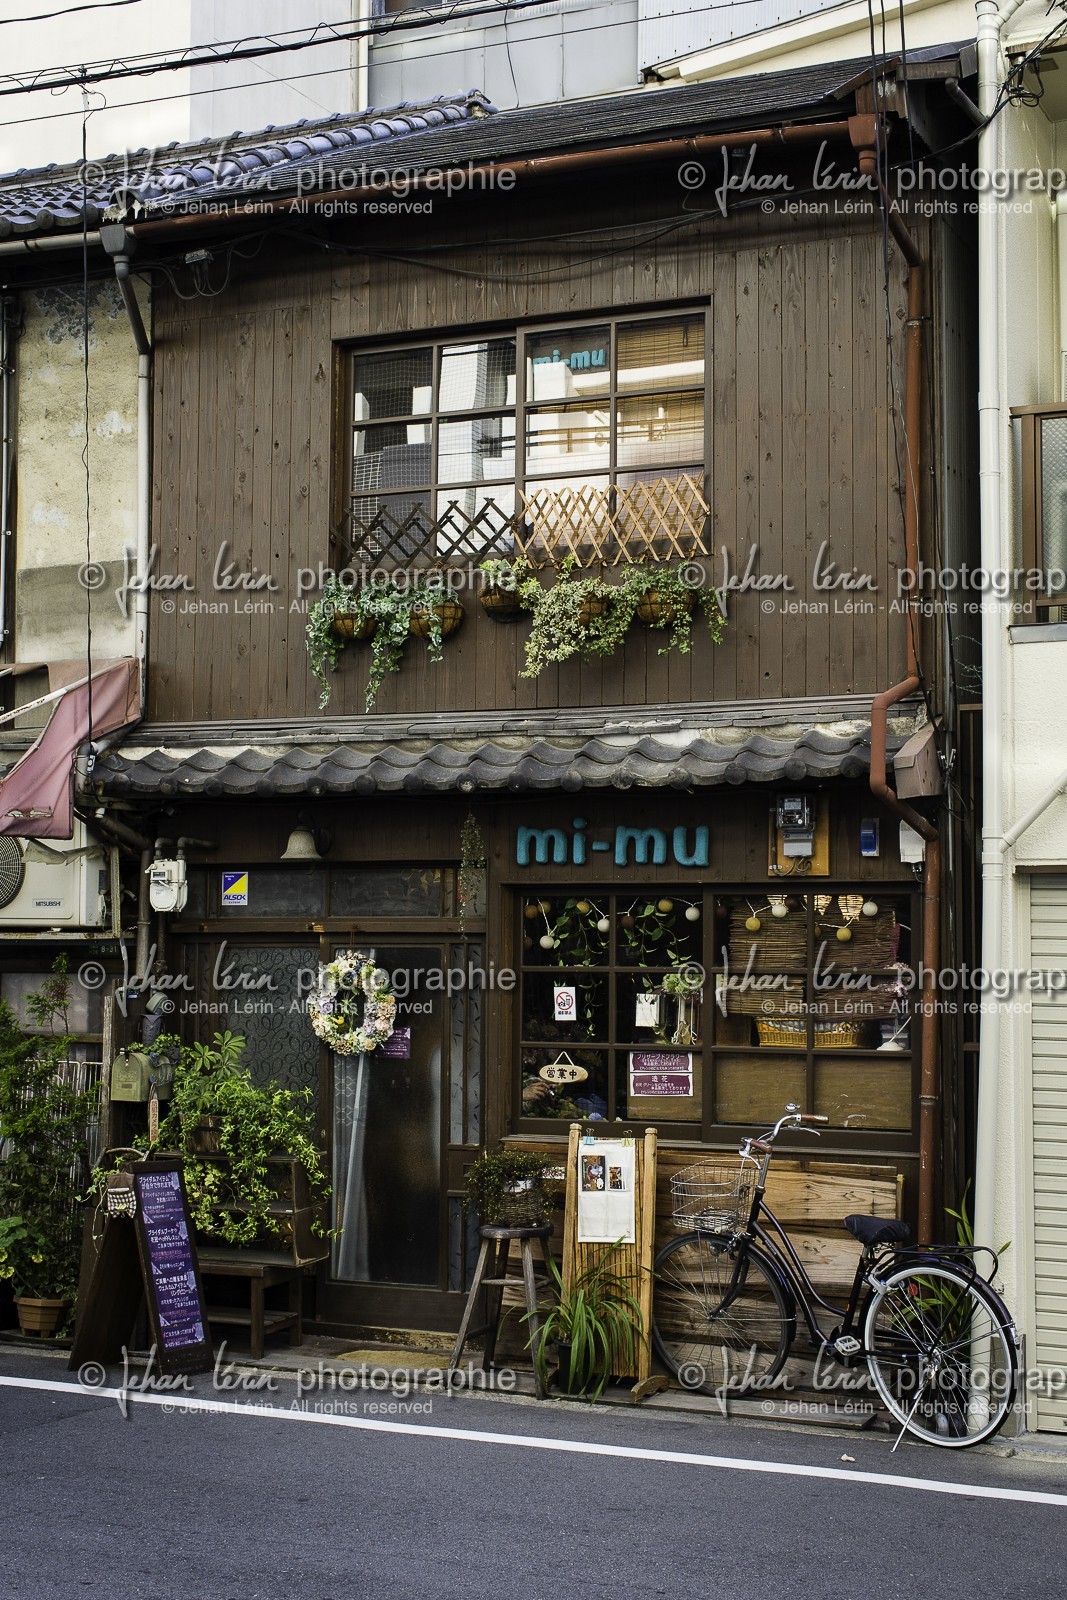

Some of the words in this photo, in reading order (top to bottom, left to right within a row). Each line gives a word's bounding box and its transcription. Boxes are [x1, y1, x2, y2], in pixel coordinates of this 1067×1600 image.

[517, 817, 709, 867] mi-mu
[546, 1067, 577, 1080] 営業中
